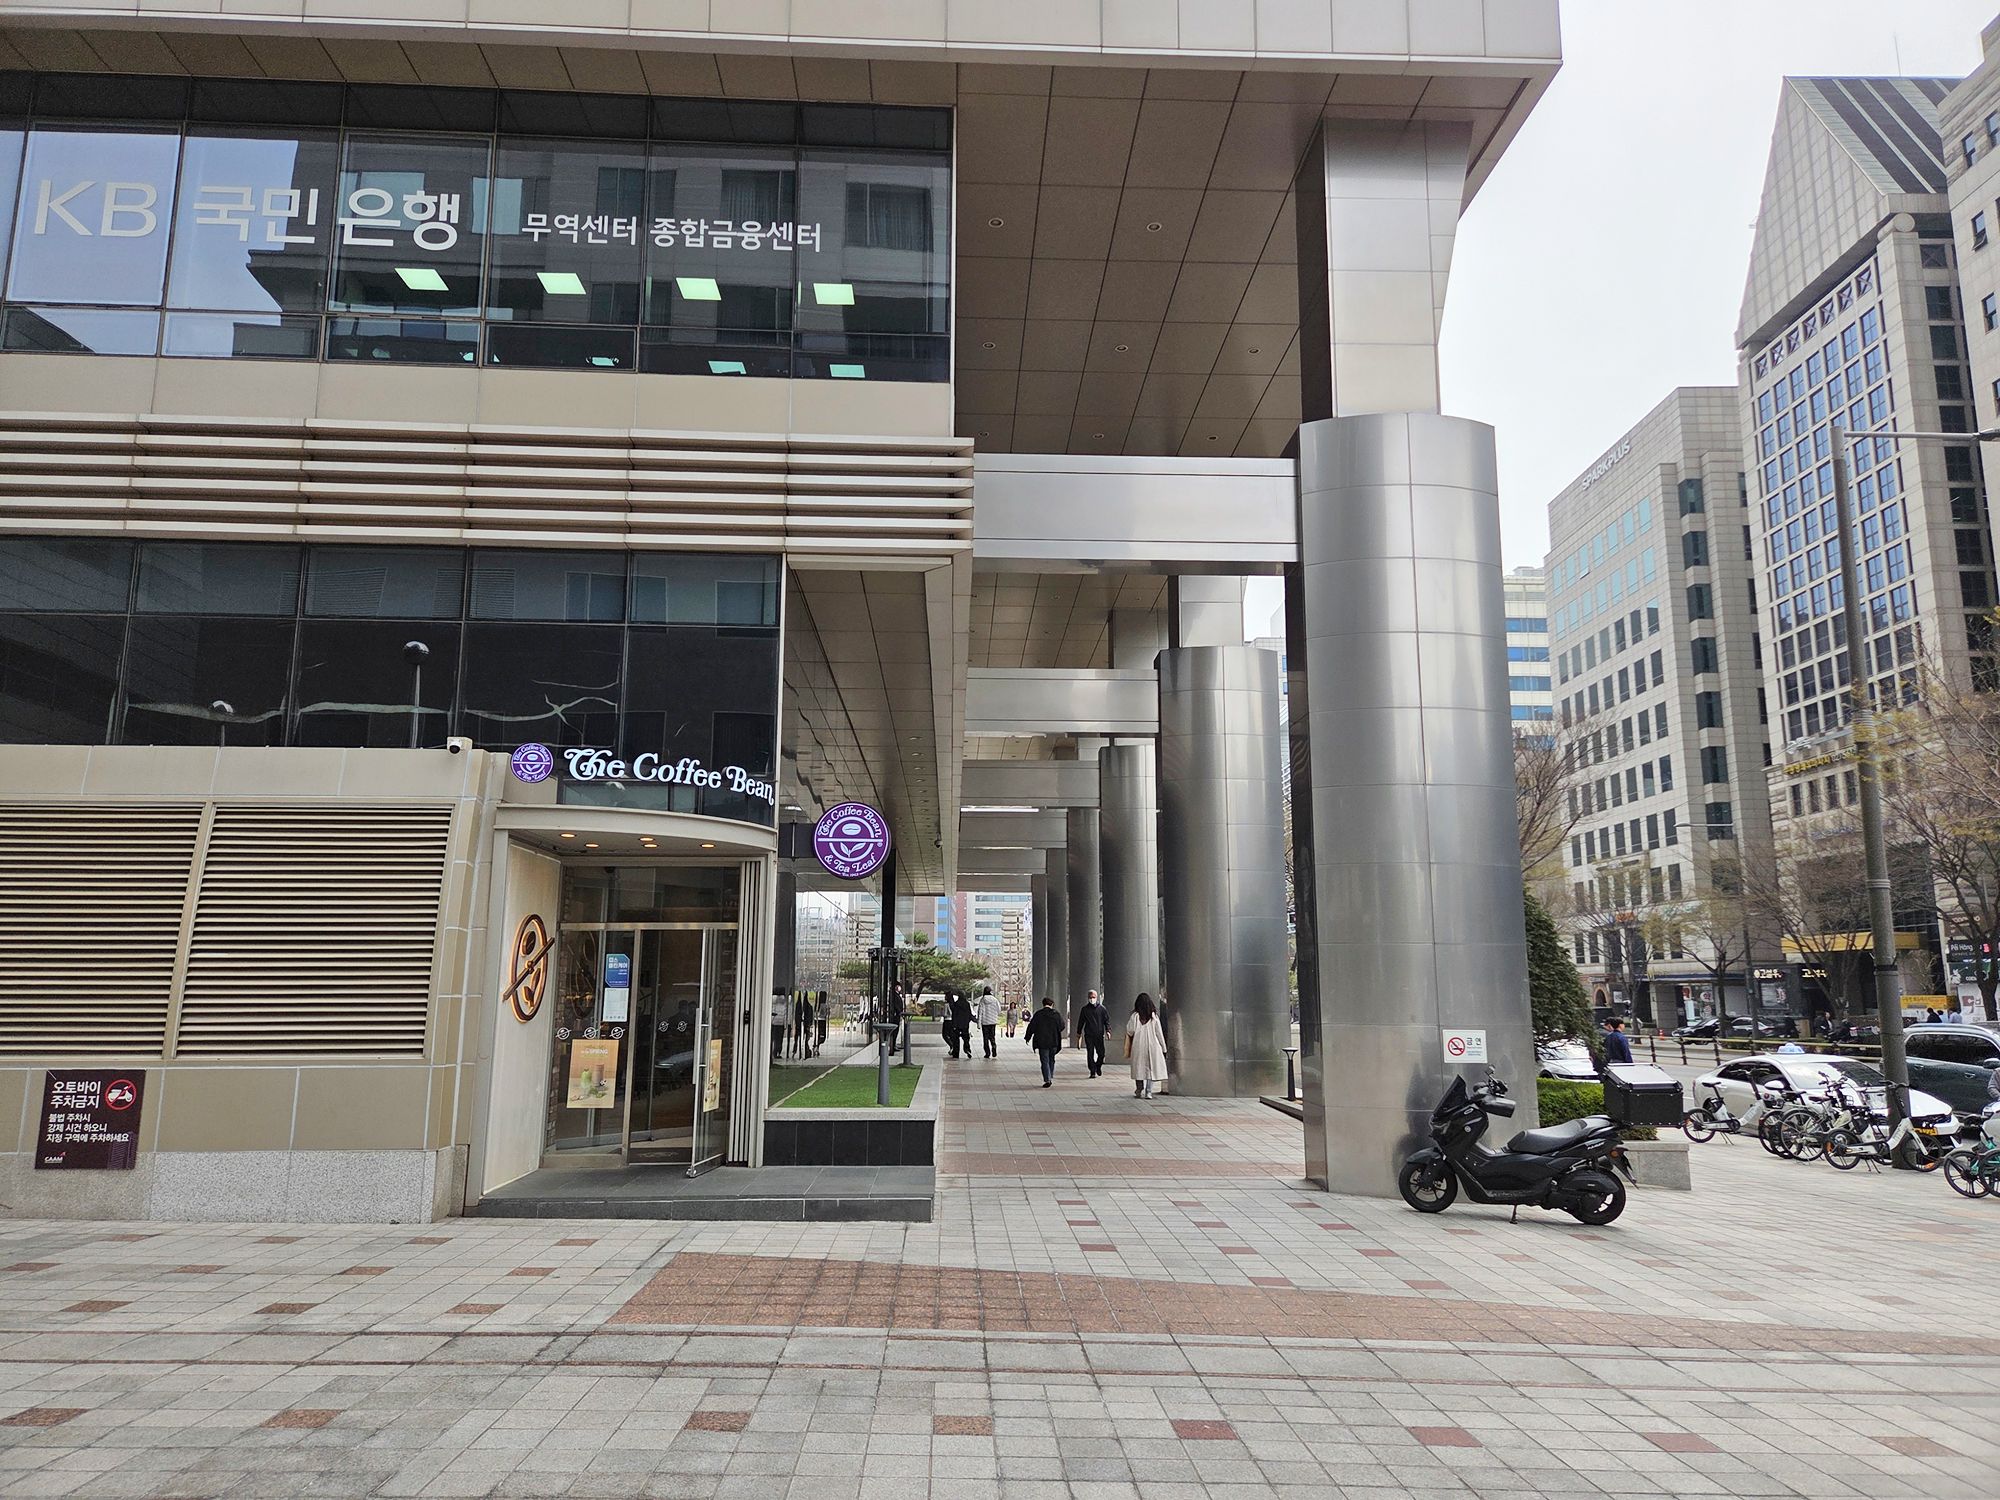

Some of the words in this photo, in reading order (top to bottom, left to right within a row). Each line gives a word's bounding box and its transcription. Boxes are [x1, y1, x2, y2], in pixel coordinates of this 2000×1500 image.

[33, 180, 158, 238] KB
[193, 184, 459, 251] 국민은행
[521, 212, 638, 246] 무역센터
[650, 216, 821, 253] 종합금융센터
[1582, 439, 1631, 490] SPARKPLUS
[563, 748, 625, 781] The
[632, 752, 722, 788] Coffee
[725, 765, 775, 806] Bean
[818, 819, 833, 836] The
[831, 805, 863, 821] Coffee
[863, 808, 883, 838] Bean
[824, 854, 834, 865] &
[833, 859, 851, 873] Tea
[851, 852, 875, 872] Leaf
[52, 1081, 101, 1094] 오토바이
[50, 1095, 100, 1109] 주차금지
[48, 1113, 66, 1123] 불법
[67, 1113, 91, 1122] 주차시
[48, 1124, 65, 1133] 강제
[83, 1123, 108, 1132] 하오니
[46, 1133, 63, 1143] 지정
[64, 1133, 89, 1143] 구역에
[90, 1133, 129, 1143] 주차하세요
